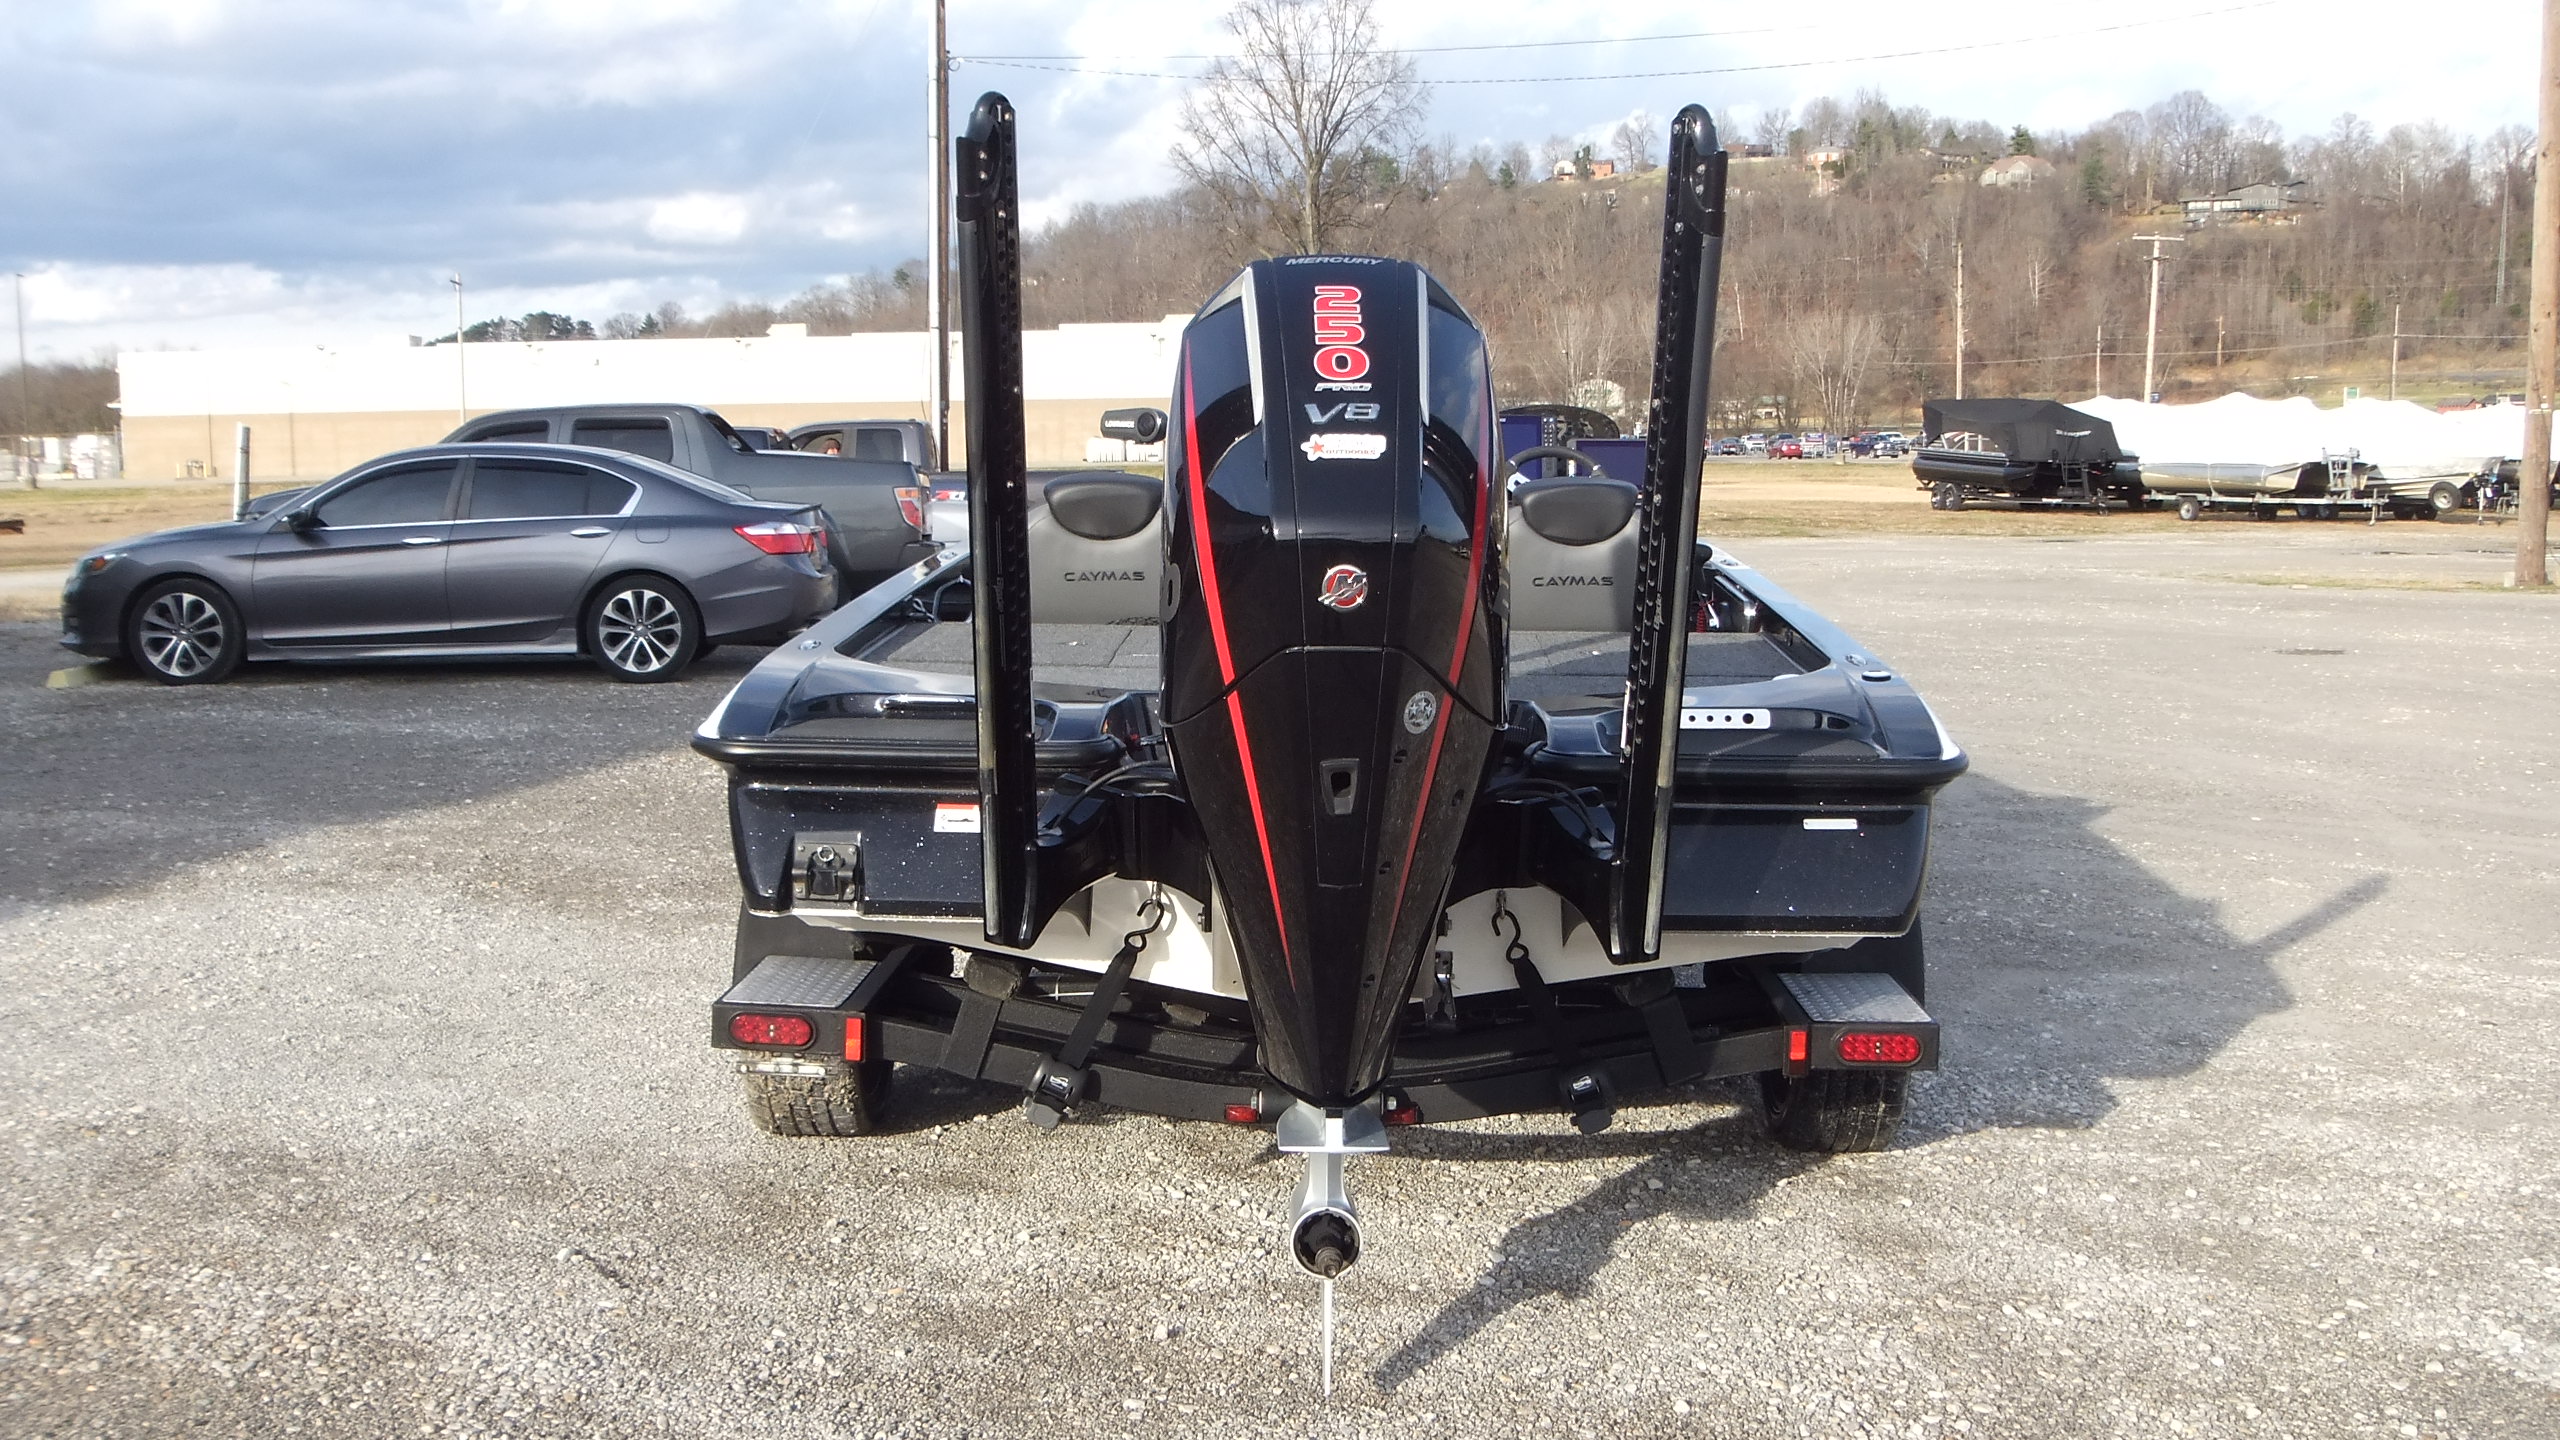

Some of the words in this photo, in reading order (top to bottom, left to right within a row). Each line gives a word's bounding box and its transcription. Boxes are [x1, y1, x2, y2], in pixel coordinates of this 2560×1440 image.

[1284, 256, 1384, 266] MERCURY
[1313, 285, 1370, 381] 250
[1313, 382, 1373, 393] PRO
[1303, 402, 1381, 425] V8
[1063, 570, 1146, 582] CAYMAS
[1531, 575, 1615, 588] CAYMAS
